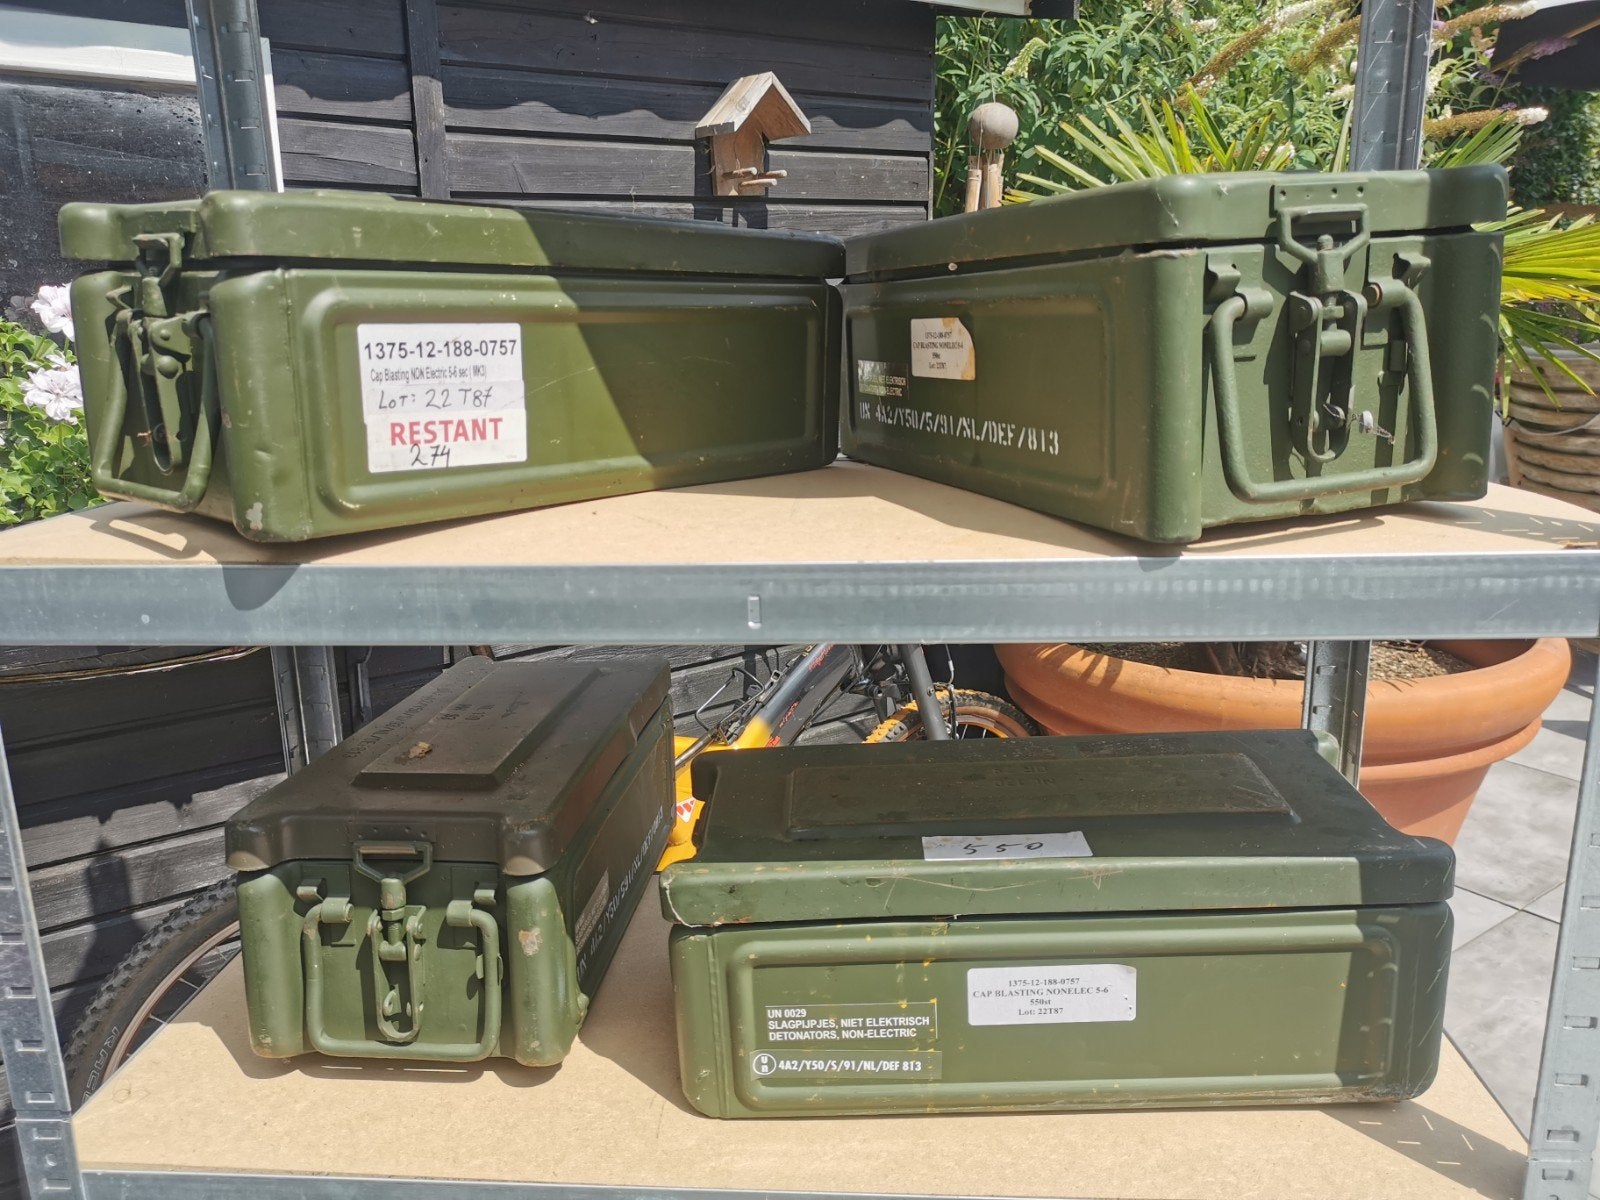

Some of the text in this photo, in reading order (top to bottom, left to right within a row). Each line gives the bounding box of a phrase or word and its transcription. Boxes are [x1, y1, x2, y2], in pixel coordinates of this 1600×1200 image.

[364, 340, 517, 360] 1375-12-188-0757
[370, 368, 382, 385] Cap
[384, 368, 410, 384] Blasting
[426, 366, 447, 379] Electric
[459, 367, 468, 378] sec
[425, 389, 452, 410] 22
[458, 386, 493, 408] T87
[390, 418, 503, 446] RESTANT
[410, 444, 451, 467] 274
[963, 842, 1043, 855] 550
[1008, 978, 1080, 987] 1375-12-188-0757
[973, 986, 1109, 998] CAP BLASTING NONELEC 5-6
[1030, 998, 1052, 1006] 550st
[767, 1008, 807, 1019] UN 0029
[1018, 1007, 1064, 1016] Lot: 22T87
[768, 1016, 929, 1030] SLAGPIJPJES, NIET ELEKTRISCH
[769, 1028, 917, 1041] DETONATORS, NON-ELECTRIC
[902, 1061, 922, 1072] 813
